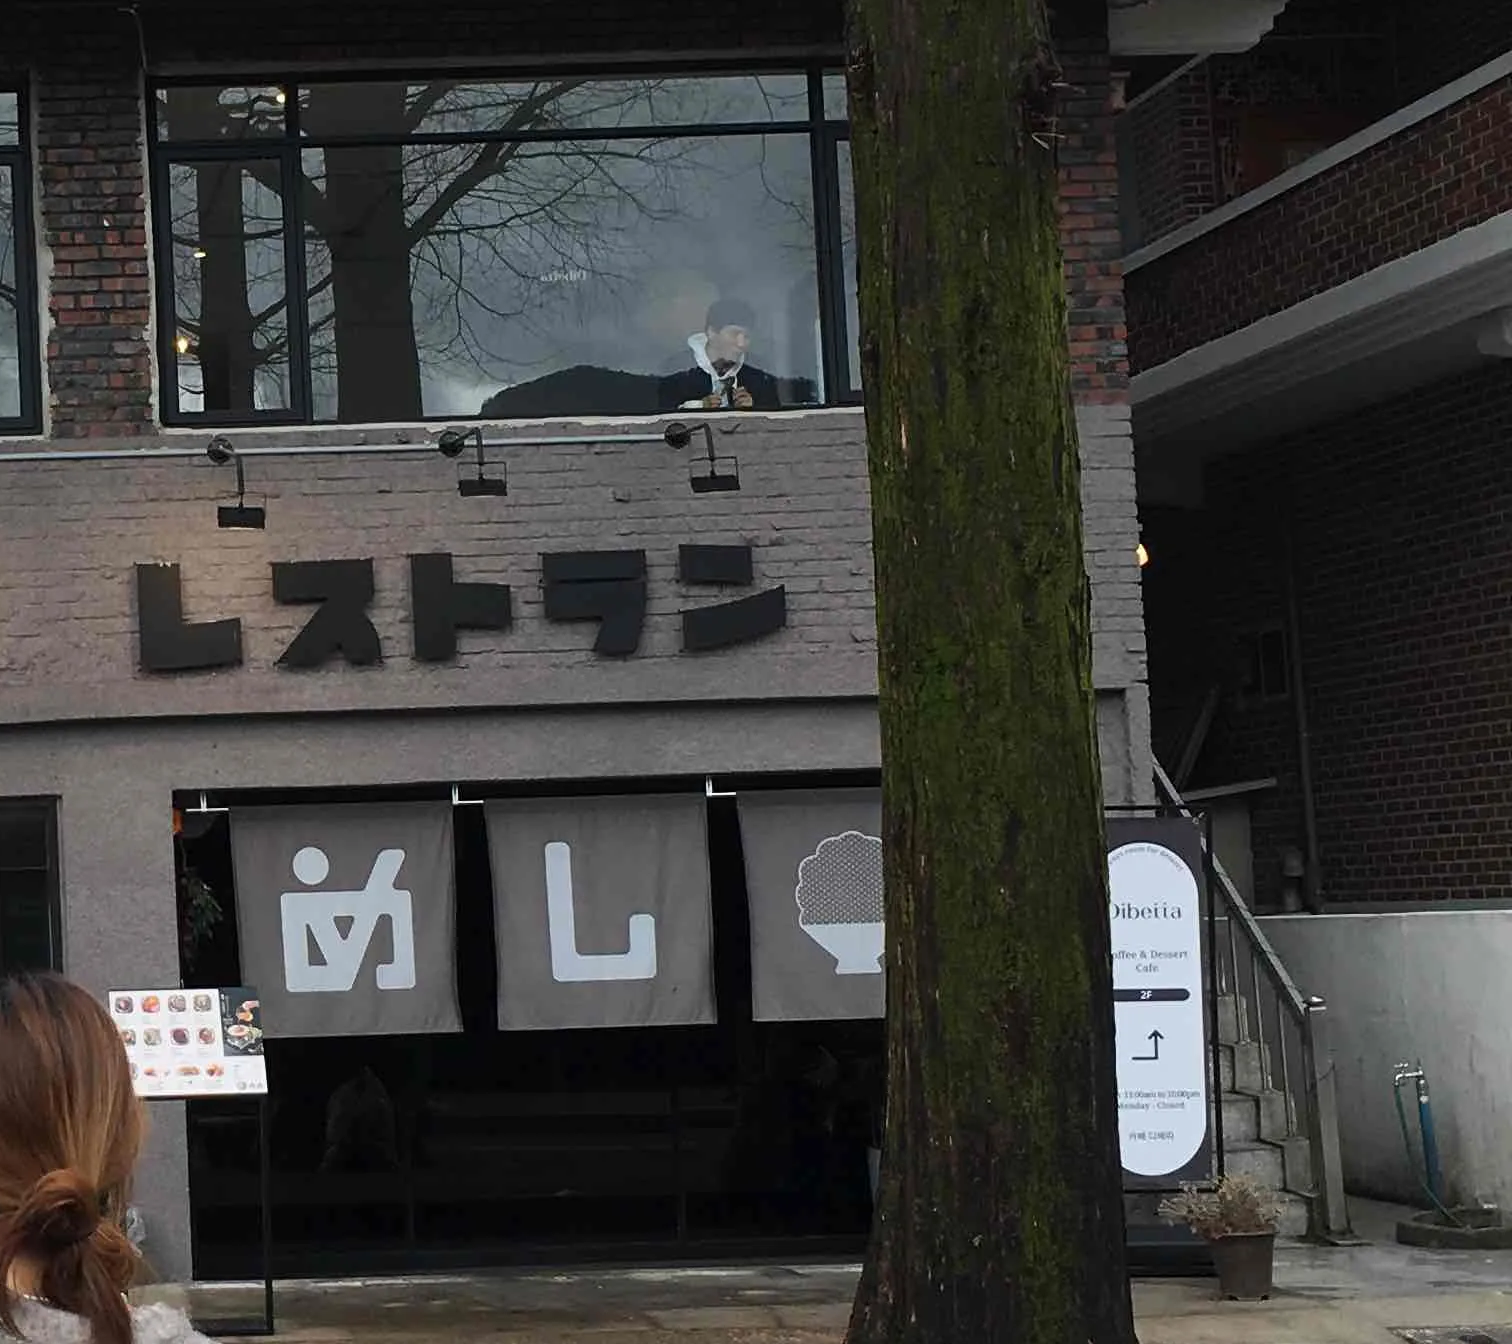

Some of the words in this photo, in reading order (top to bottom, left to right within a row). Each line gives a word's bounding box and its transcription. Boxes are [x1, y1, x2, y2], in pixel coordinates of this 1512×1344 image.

[136, 543, 786, 674] レストラン
[1111, 949, 1138, 960] offee
[1139, 989, 1154, 1001] 2F
